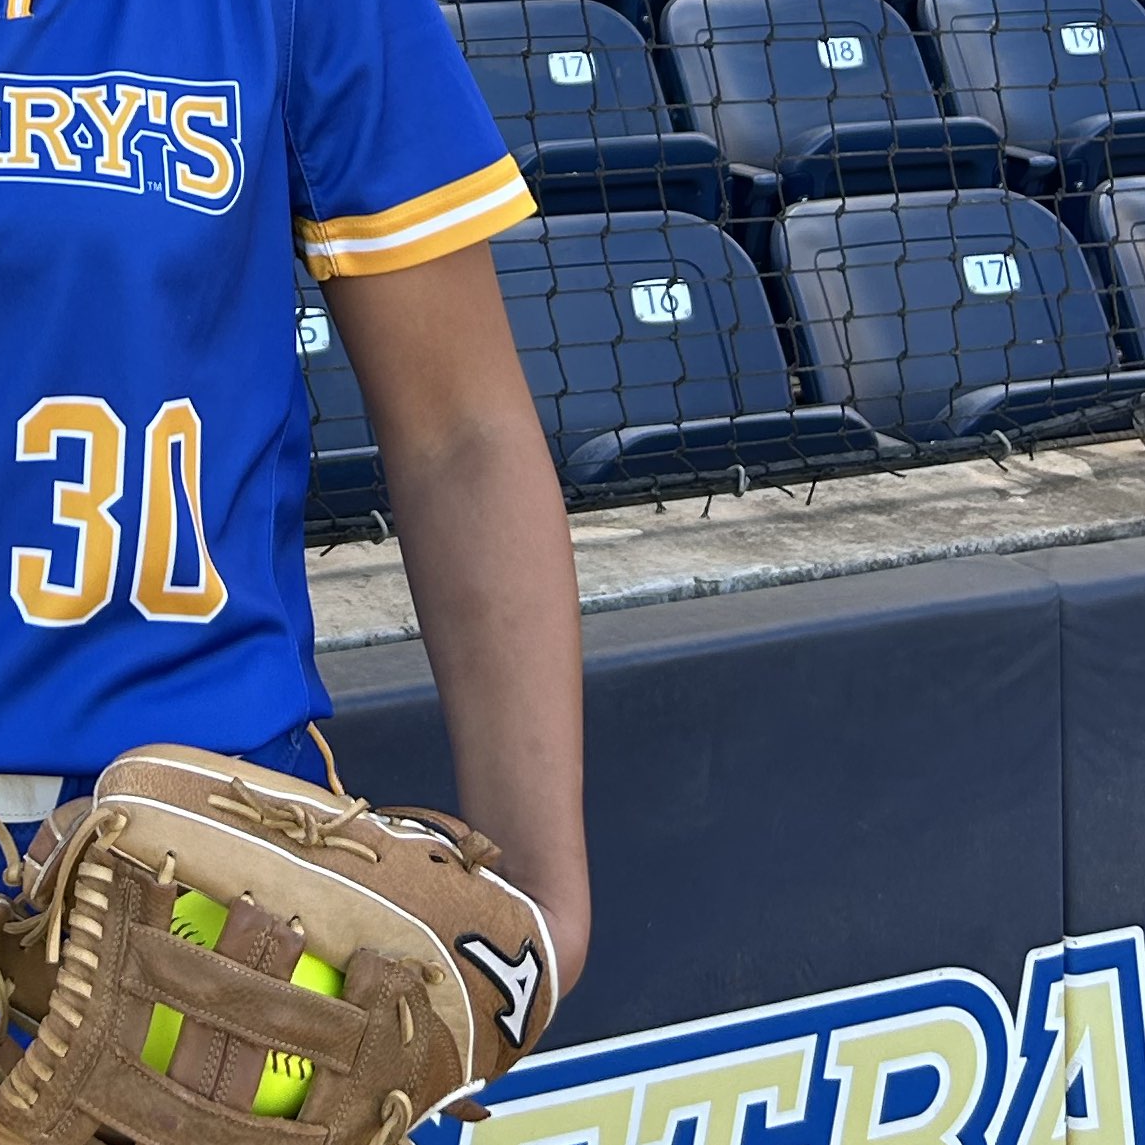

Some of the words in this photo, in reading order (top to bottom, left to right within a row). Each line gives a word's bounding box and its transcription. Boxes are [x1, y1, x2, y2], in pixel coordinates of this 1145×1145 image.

[1071, 27, 1094, 48] 19
[829, 41, 854, 61] 18
[559, 56, 583, 77] 17
[975, 260, 1004, 286] 17
[643, 285, 679, 313] 16
[10, 396, 229, 627] 30
